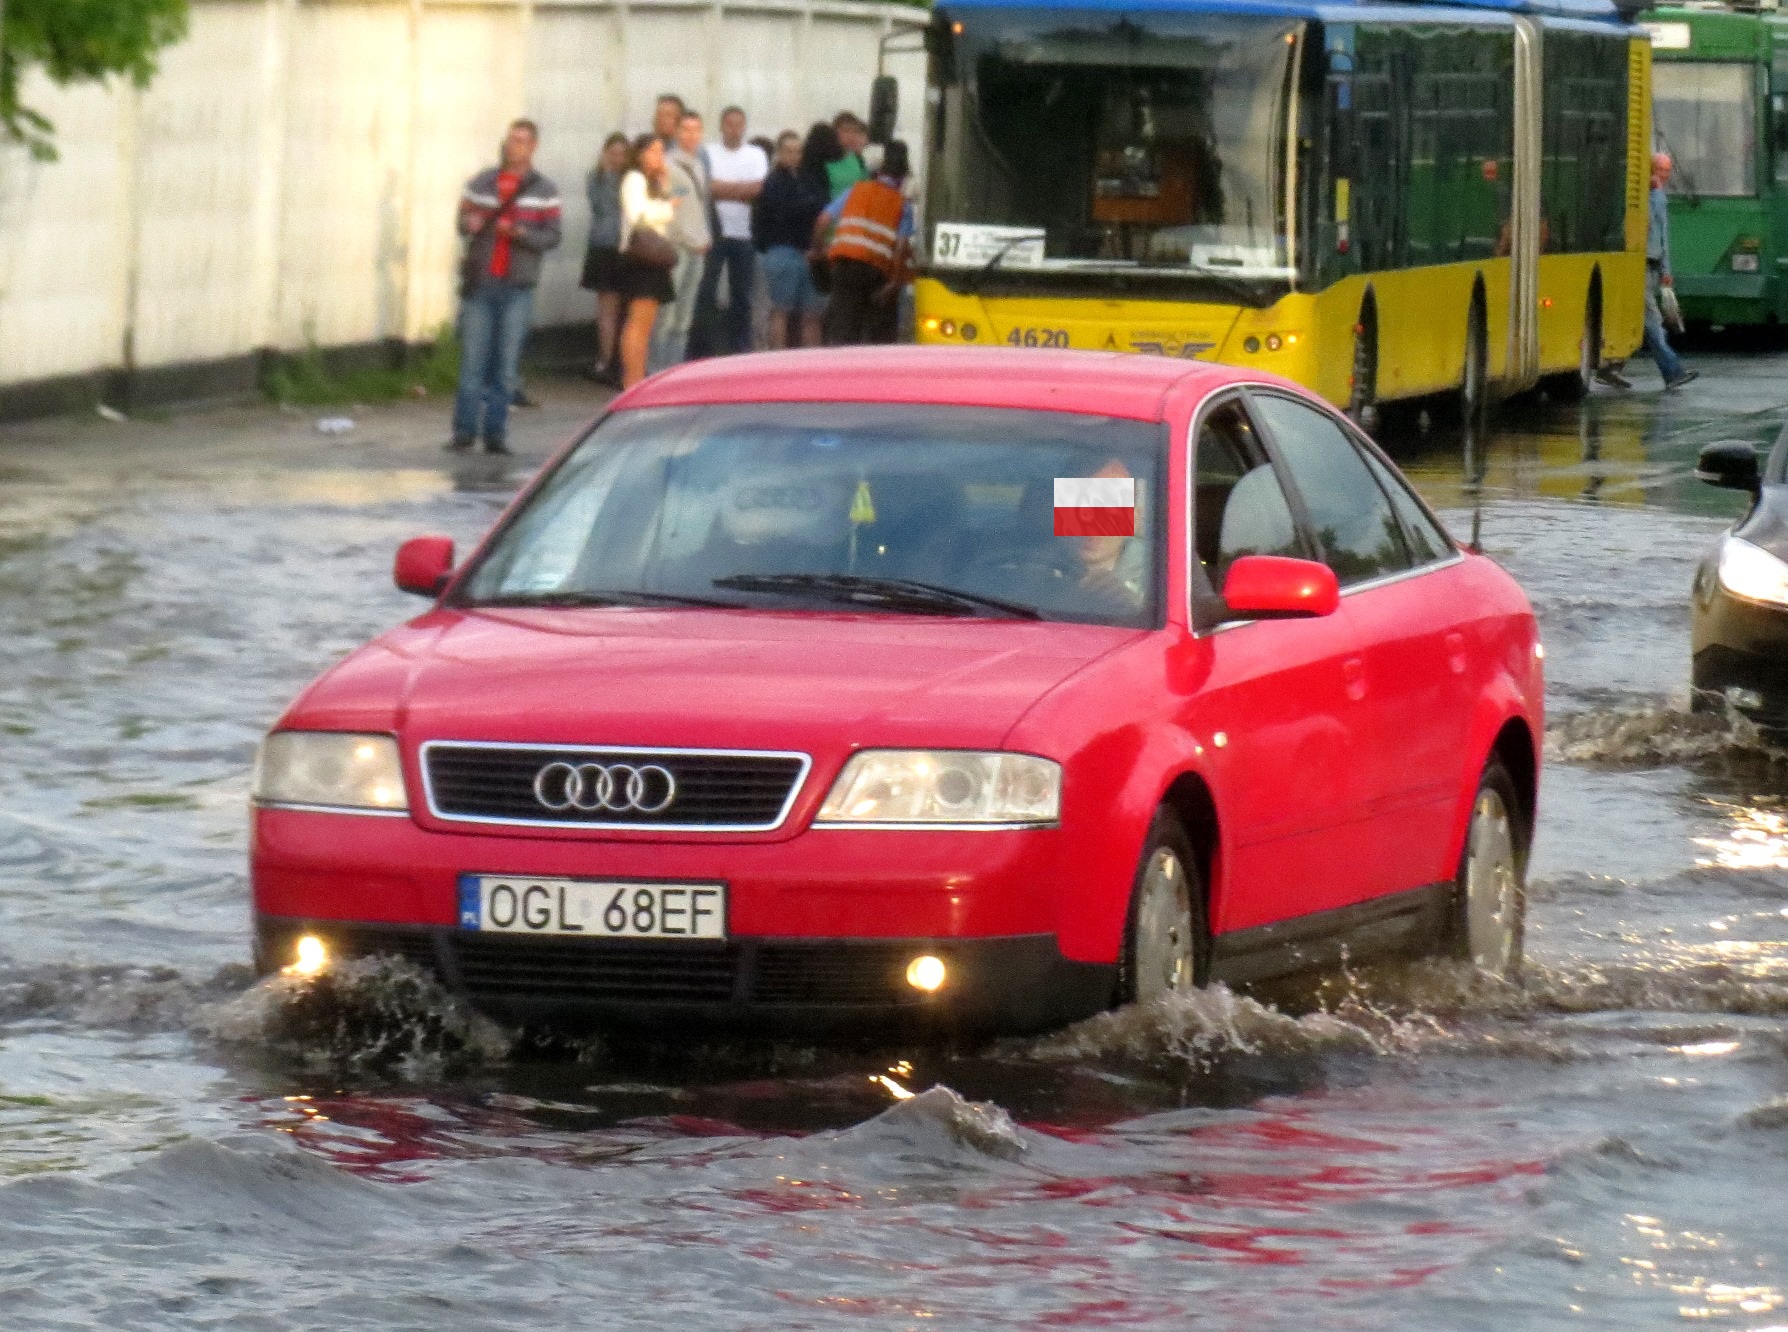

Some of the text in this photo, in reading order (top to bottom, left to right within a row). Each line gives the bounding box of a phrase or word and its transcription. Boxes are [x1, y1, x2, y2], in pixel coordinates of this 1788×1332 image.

[939, 232, 961, 257] 37
[1007, 327, 1069, 348] 4620
[489, 884, 718, 935] OGL 68EF
